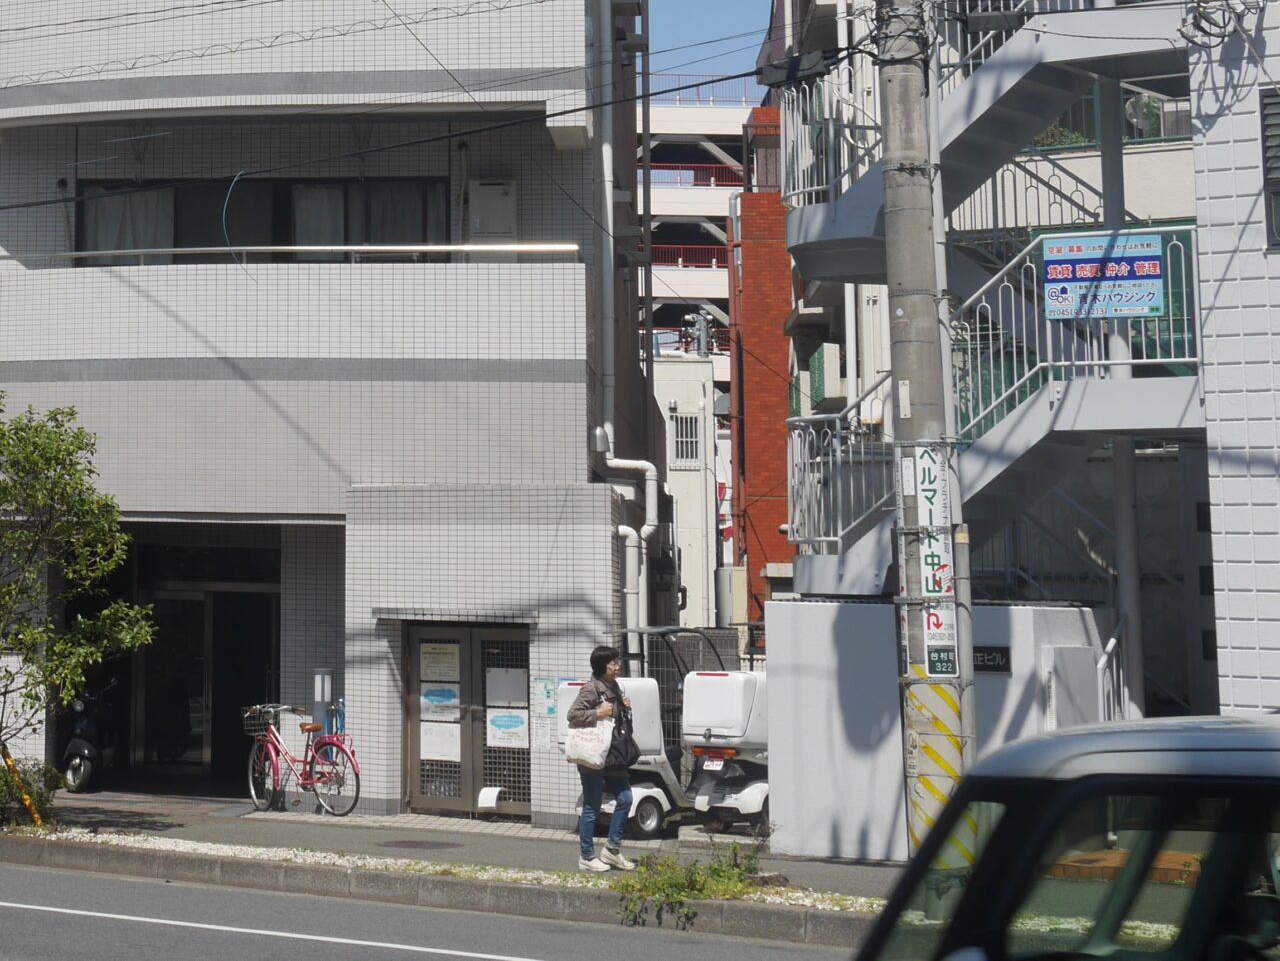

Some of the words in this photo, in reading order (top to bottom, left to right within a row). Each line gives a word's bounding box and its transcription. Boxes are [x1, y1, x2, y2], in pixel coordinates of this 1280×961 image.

[1047, 265, 1073, 279] 賃貸
[1105, 262, 1131, 277] 仲介
[1134, 260, 1161, 276] 管理
[1078, 291, 1157, 305] 青木ハウジング
[920, 449, 943, 594] ヘルマート中山
[935, 662, 953, 672] 322
